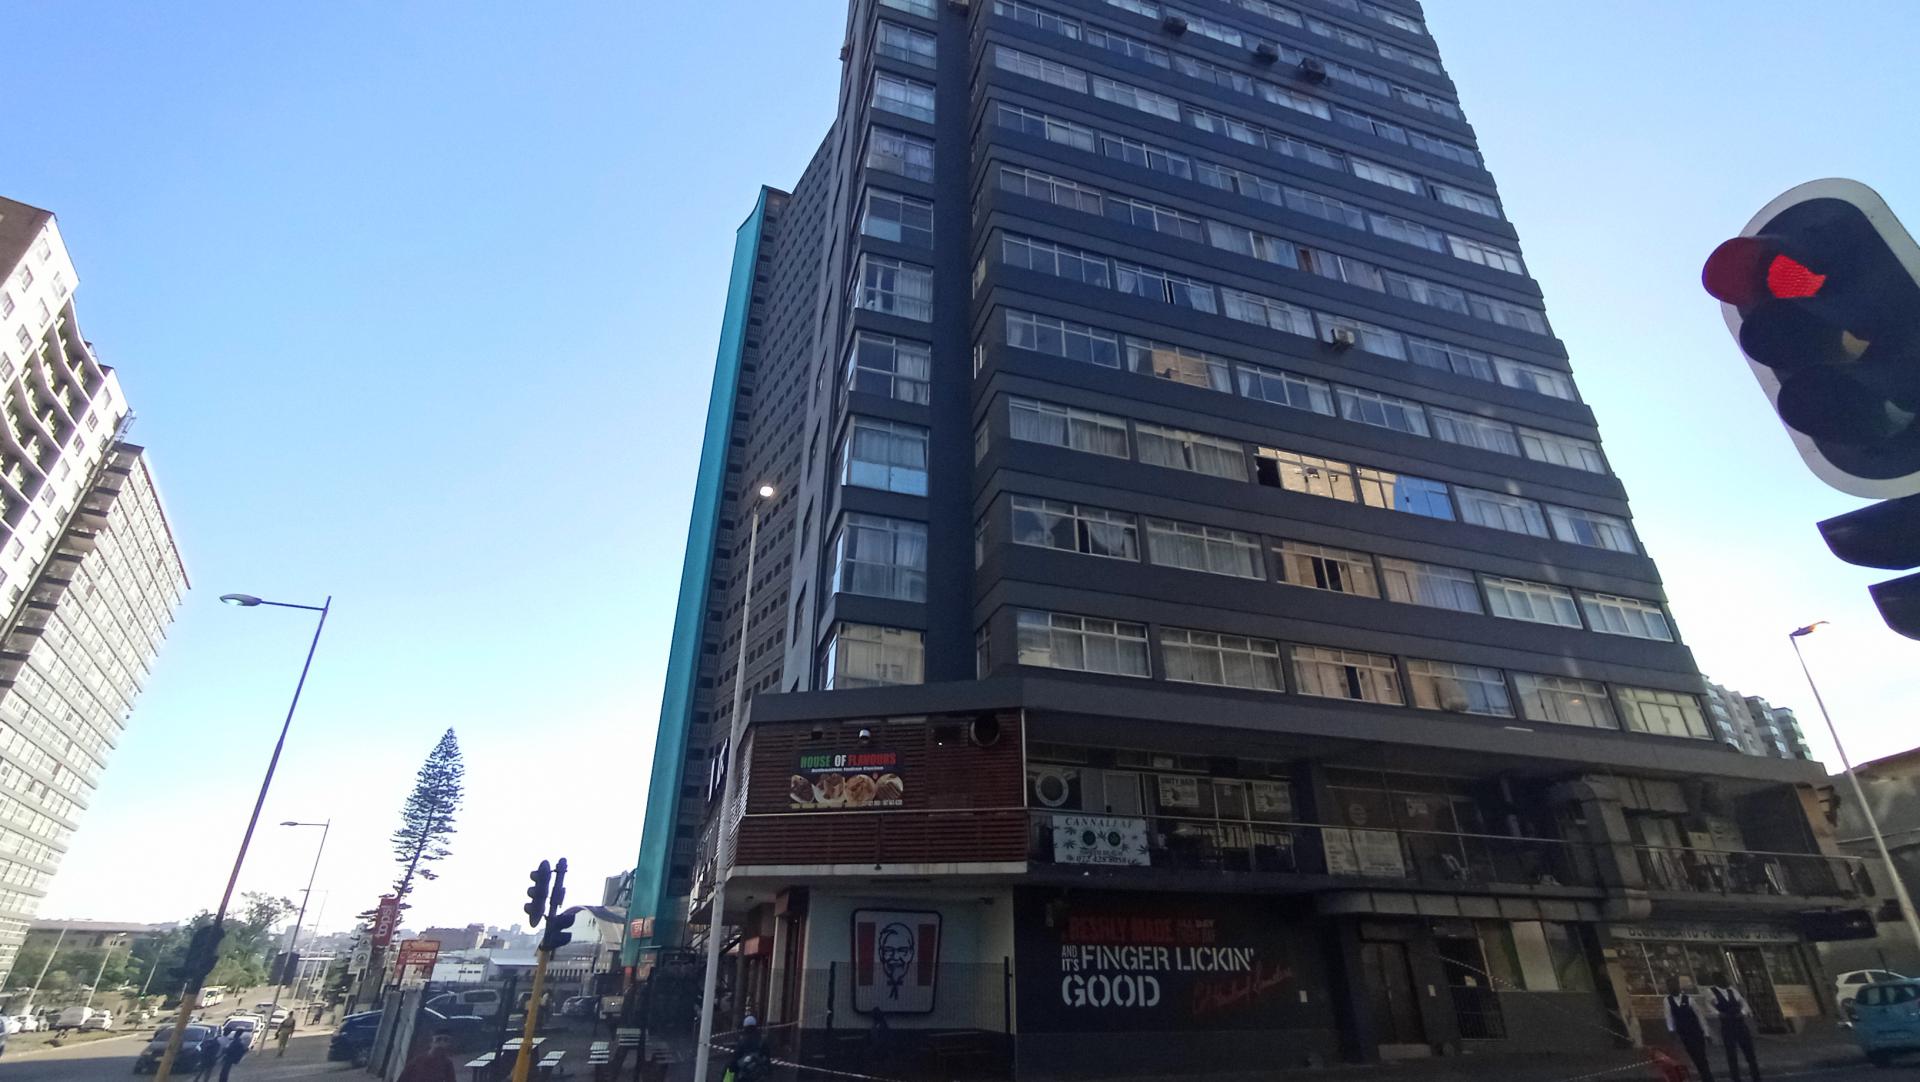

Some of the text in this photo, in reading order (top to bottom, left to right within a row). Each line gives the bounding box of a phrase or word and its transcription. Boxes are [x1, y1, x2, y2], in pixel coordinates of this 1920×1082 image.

[800, 752, 897, 769] HOUSE OF FLAVOURS
[1061, 944, 1078, 958] AND
[1081, 945, 1255, 972] FINGER LICKIN'
[1061, 958, 1079, 972] IT'S
[1061, 974, 1161, 1008] GOOD
